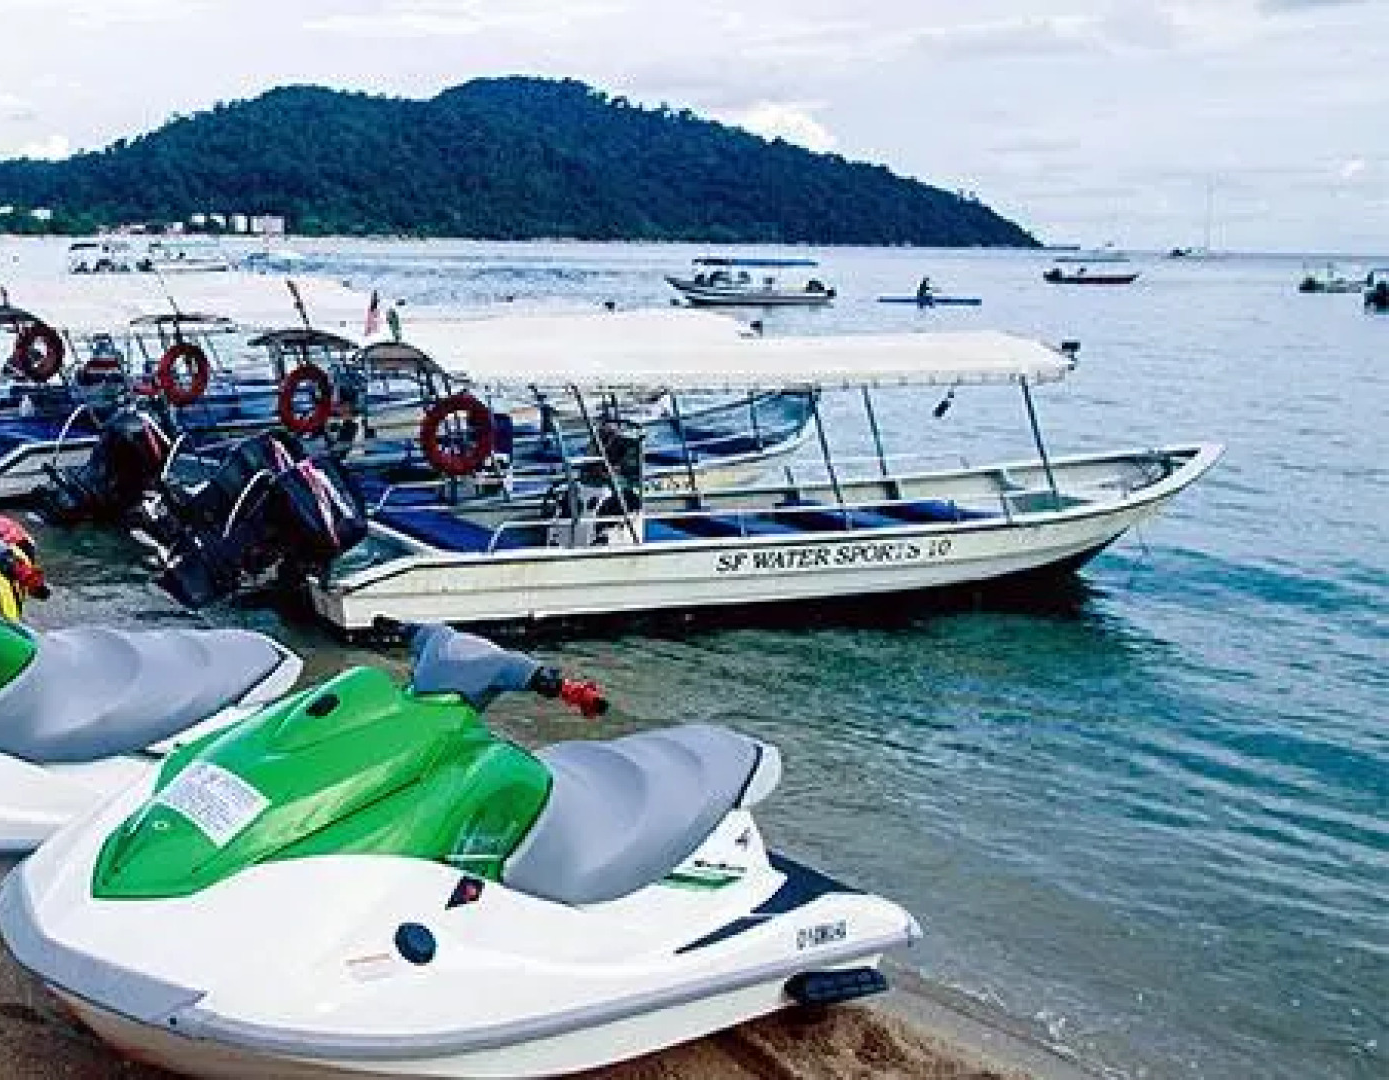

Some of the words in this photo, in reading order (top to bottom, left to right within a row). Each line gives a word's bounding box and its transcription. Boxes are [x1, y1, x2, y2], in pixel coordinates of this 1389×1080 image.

[716, 551, 747, 571] SF
[753, 548, 829, 569] WATER
[835, 544, 921, 564] SPORTS
